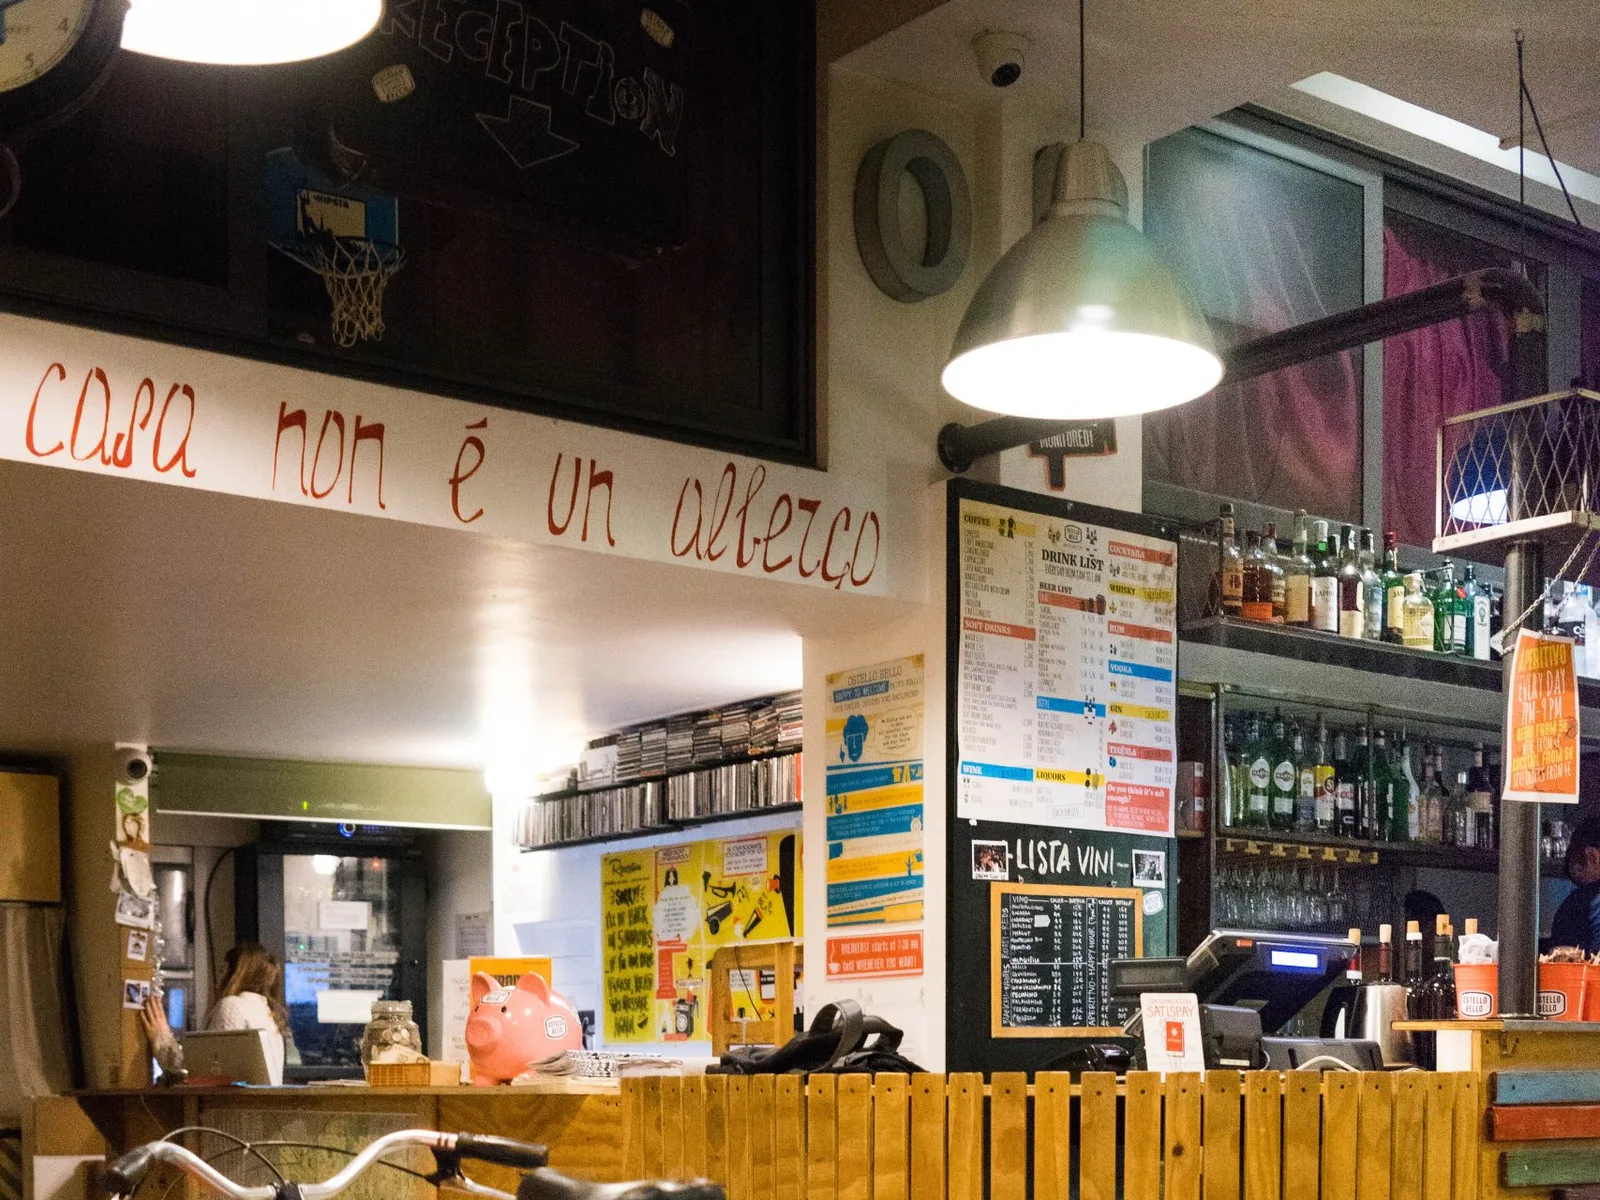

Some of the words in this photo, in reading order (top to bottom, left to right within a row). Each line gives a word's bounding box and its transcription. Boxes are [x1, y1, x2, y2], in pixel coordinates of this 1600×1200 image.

[1040, 429, 1094, 448] MONITORED!
[25, 363, 197, 478] casa
[272, 401, 386, 510] non
[547, 452, 616, 547] un
[964, 514, 991, 526] COFFEE
[1109, 545, 1145, 559] COCKTAILS
[1041, 549, 1077, 566] DRINK
[1080, 557, 1104, 571] LIST
[1040, 582, 1057, 592] BEER
[1057, 584, 1073, 594] LIST
[1109, 583, 1136, 596] WHISKY
[964, 620, 983, 630] SOFT
[984, 623, 1011, 634] DRINKS
[1109, 623, 1125, 634] RUM
[1519, 644, 1567, 672] APERITIVO
[1110, 663, 1133, 674] VODKA
[1519, 672, 1543, 701] EVERY
[1546, 669, 1565, 696] DAY
[1110, 704, 1123, 713] GIN
[962, 764, 982, 775] WINE
[1036, 771, 1066, 781] LIQUORS
[1116, 786, 1127, 794] you
[1128, 786, 1144, 795] think
[1107, 795, 1131, 804] enough?
[1016, 838, 1071, 875] LISTA
[1077, 845, 1115, 877] VINI
[1012, 895, 1028, 904] VINO
[1088, 927, 1096, 949] HOUR
[1088, 950, 1096, 976] HAPPY
[1463, 995, 1487, 1004] OSTELLO
[1147, 1005, 1193, 1017] SATISPAY
[1465, 1003, 1483, 1013] BELLO
